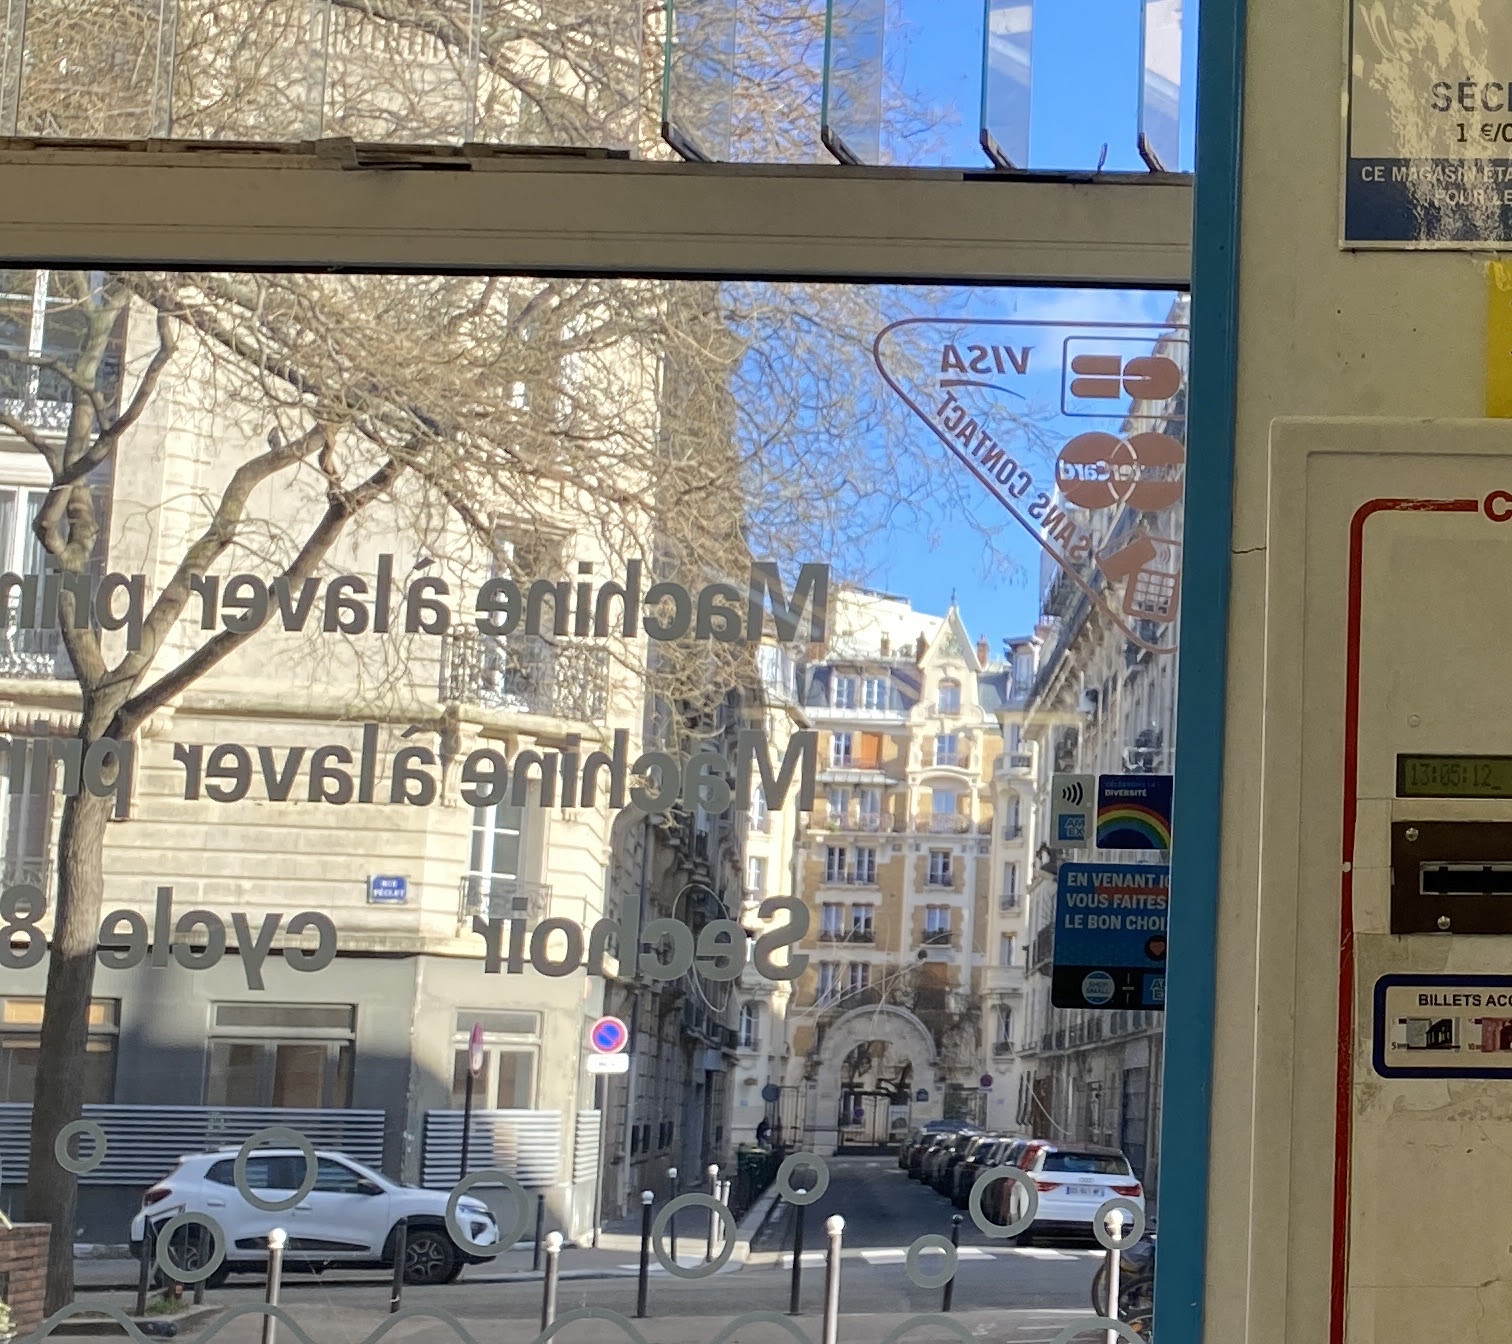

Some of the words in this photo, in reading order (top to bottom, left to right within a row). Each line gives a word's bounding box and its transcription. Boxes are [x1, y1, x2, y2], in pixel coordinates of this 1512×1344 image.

[1362, 167, 1385, 183] CE
[1104, 788, 1147, 797] DIVERSITÉ
[1067, 872, 1088, 887] EN
[1093, 873, 1156, 888] VENANT
[1066, 893, 1109, 908] VOUS
[1113, 894, 1167, 910] FAITES
[1064, 914, 1084, 929] LE
[1087, 915, 1121, 930] BON
[1125, 916, 1168, 931] CHOI
[1418, 993, 1481, 1007] BILLETS
